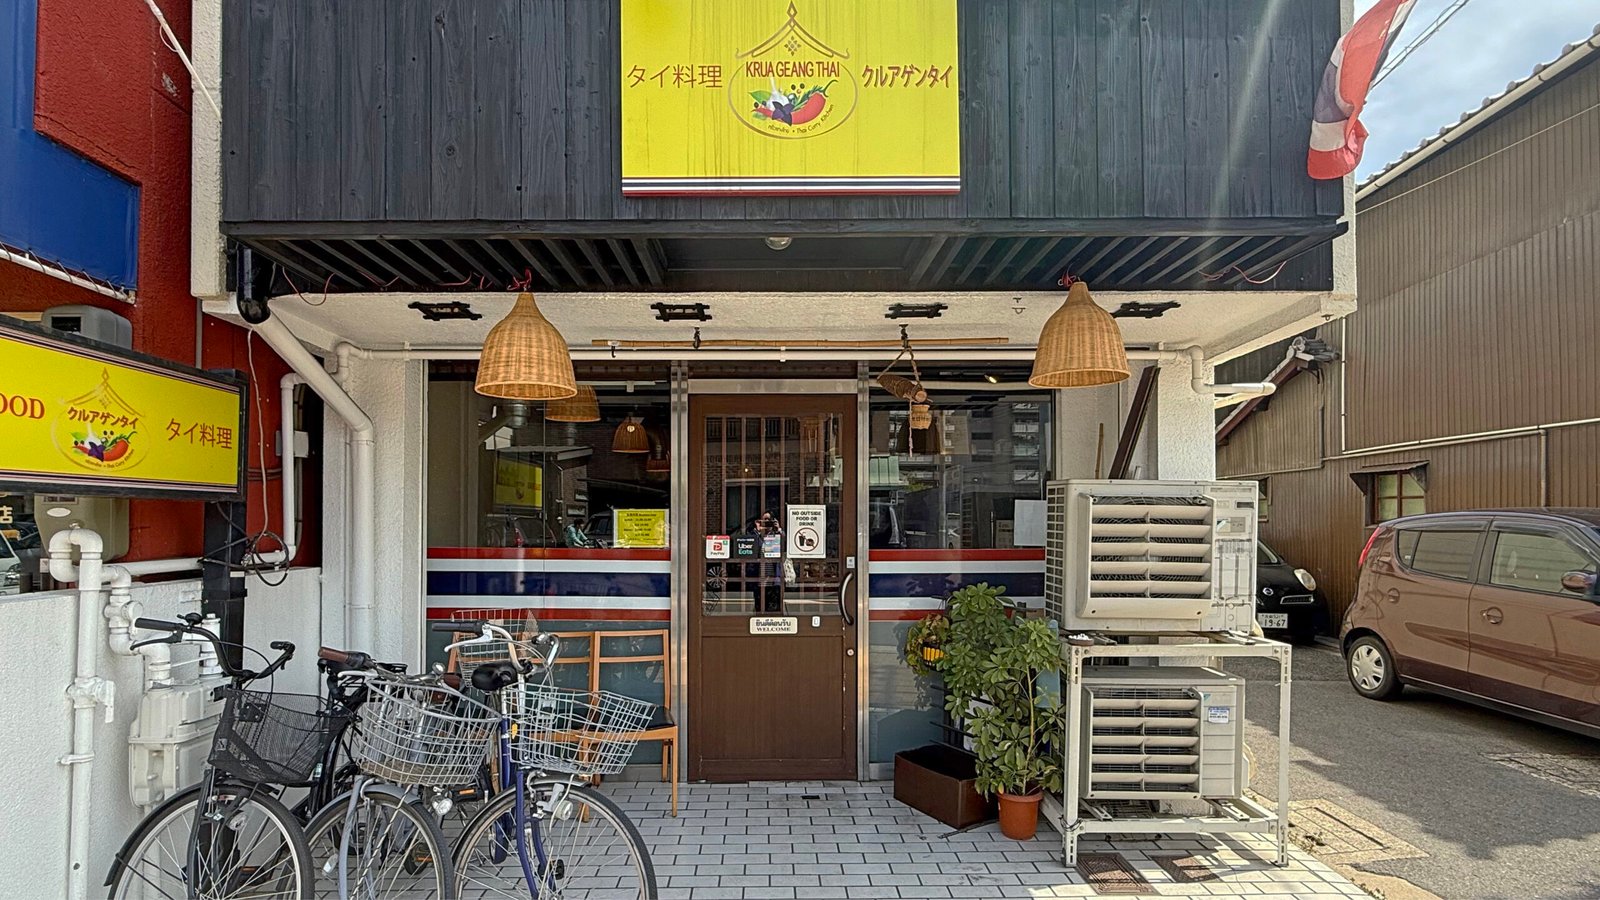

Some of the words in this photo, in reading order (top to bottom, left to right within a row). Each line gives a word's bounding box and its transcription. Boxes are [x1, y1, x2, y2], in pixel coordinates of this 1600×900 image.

[627, 64, 722, 88] タイ料理
[745, 61, 775, 77] KRUA
[776, 61, 814, 77] GEANG
[815, 61, 840, 77] THAI
[862, 64, 953, 88] クルアゲンタイ
[68, 406, 138, 429] クルアゲンタイ
[166, 418, 232, 449] タイ料理
